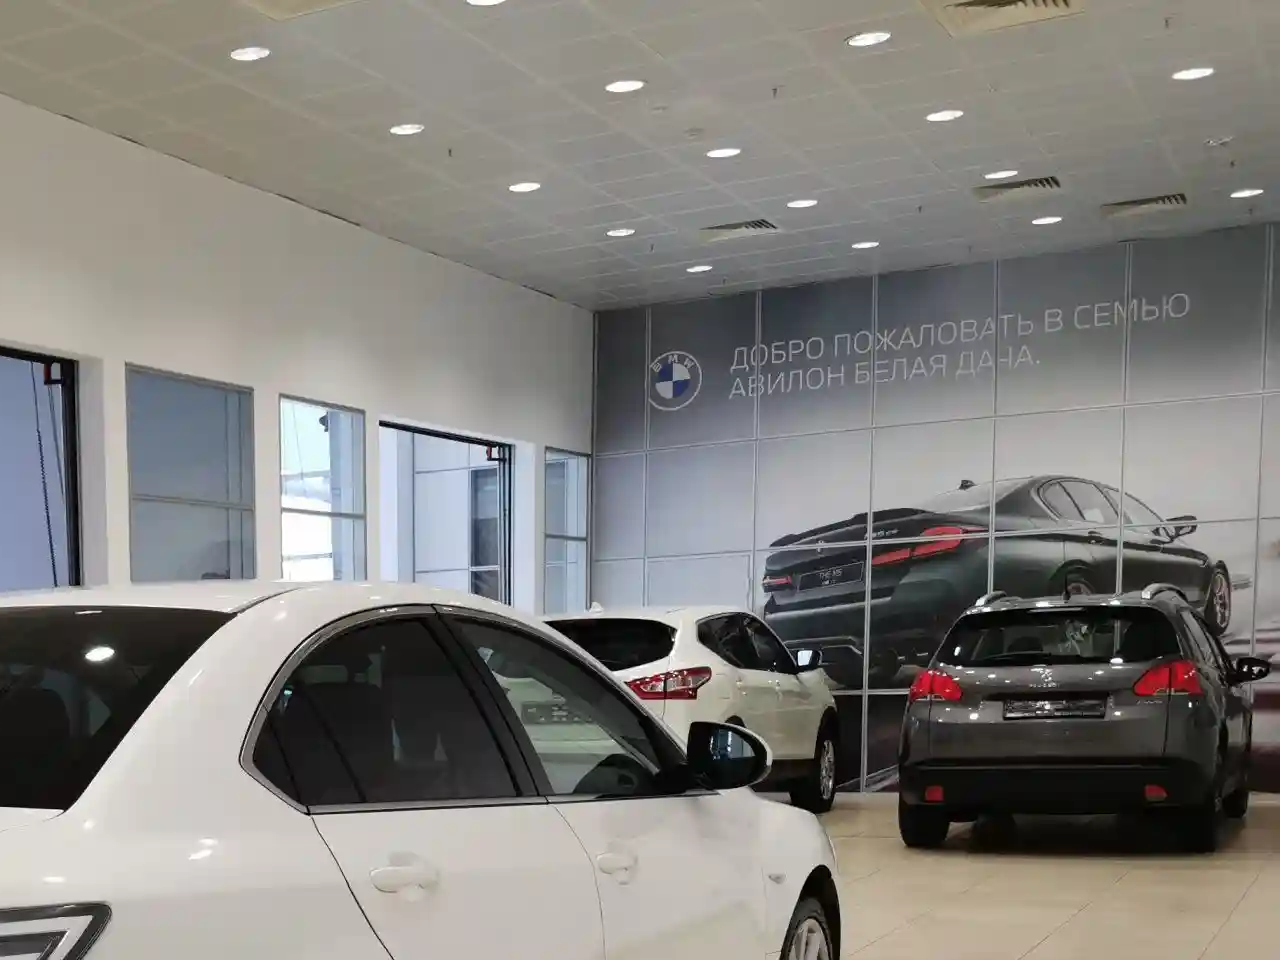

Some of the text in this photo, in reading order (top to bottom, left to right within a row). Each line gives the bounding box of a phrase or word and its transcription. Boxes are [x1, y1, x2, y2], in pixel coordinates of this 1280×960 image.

[730, 293, 1190, 374] ДОБРО ПОЖАЛОВАТЬ В СЕМЬЮ
[651, 354, 695, 373] BMW
[728, 364, 845, 400] АВИЛОН
[854, 354, 947, 384] БЕЛАЯ
